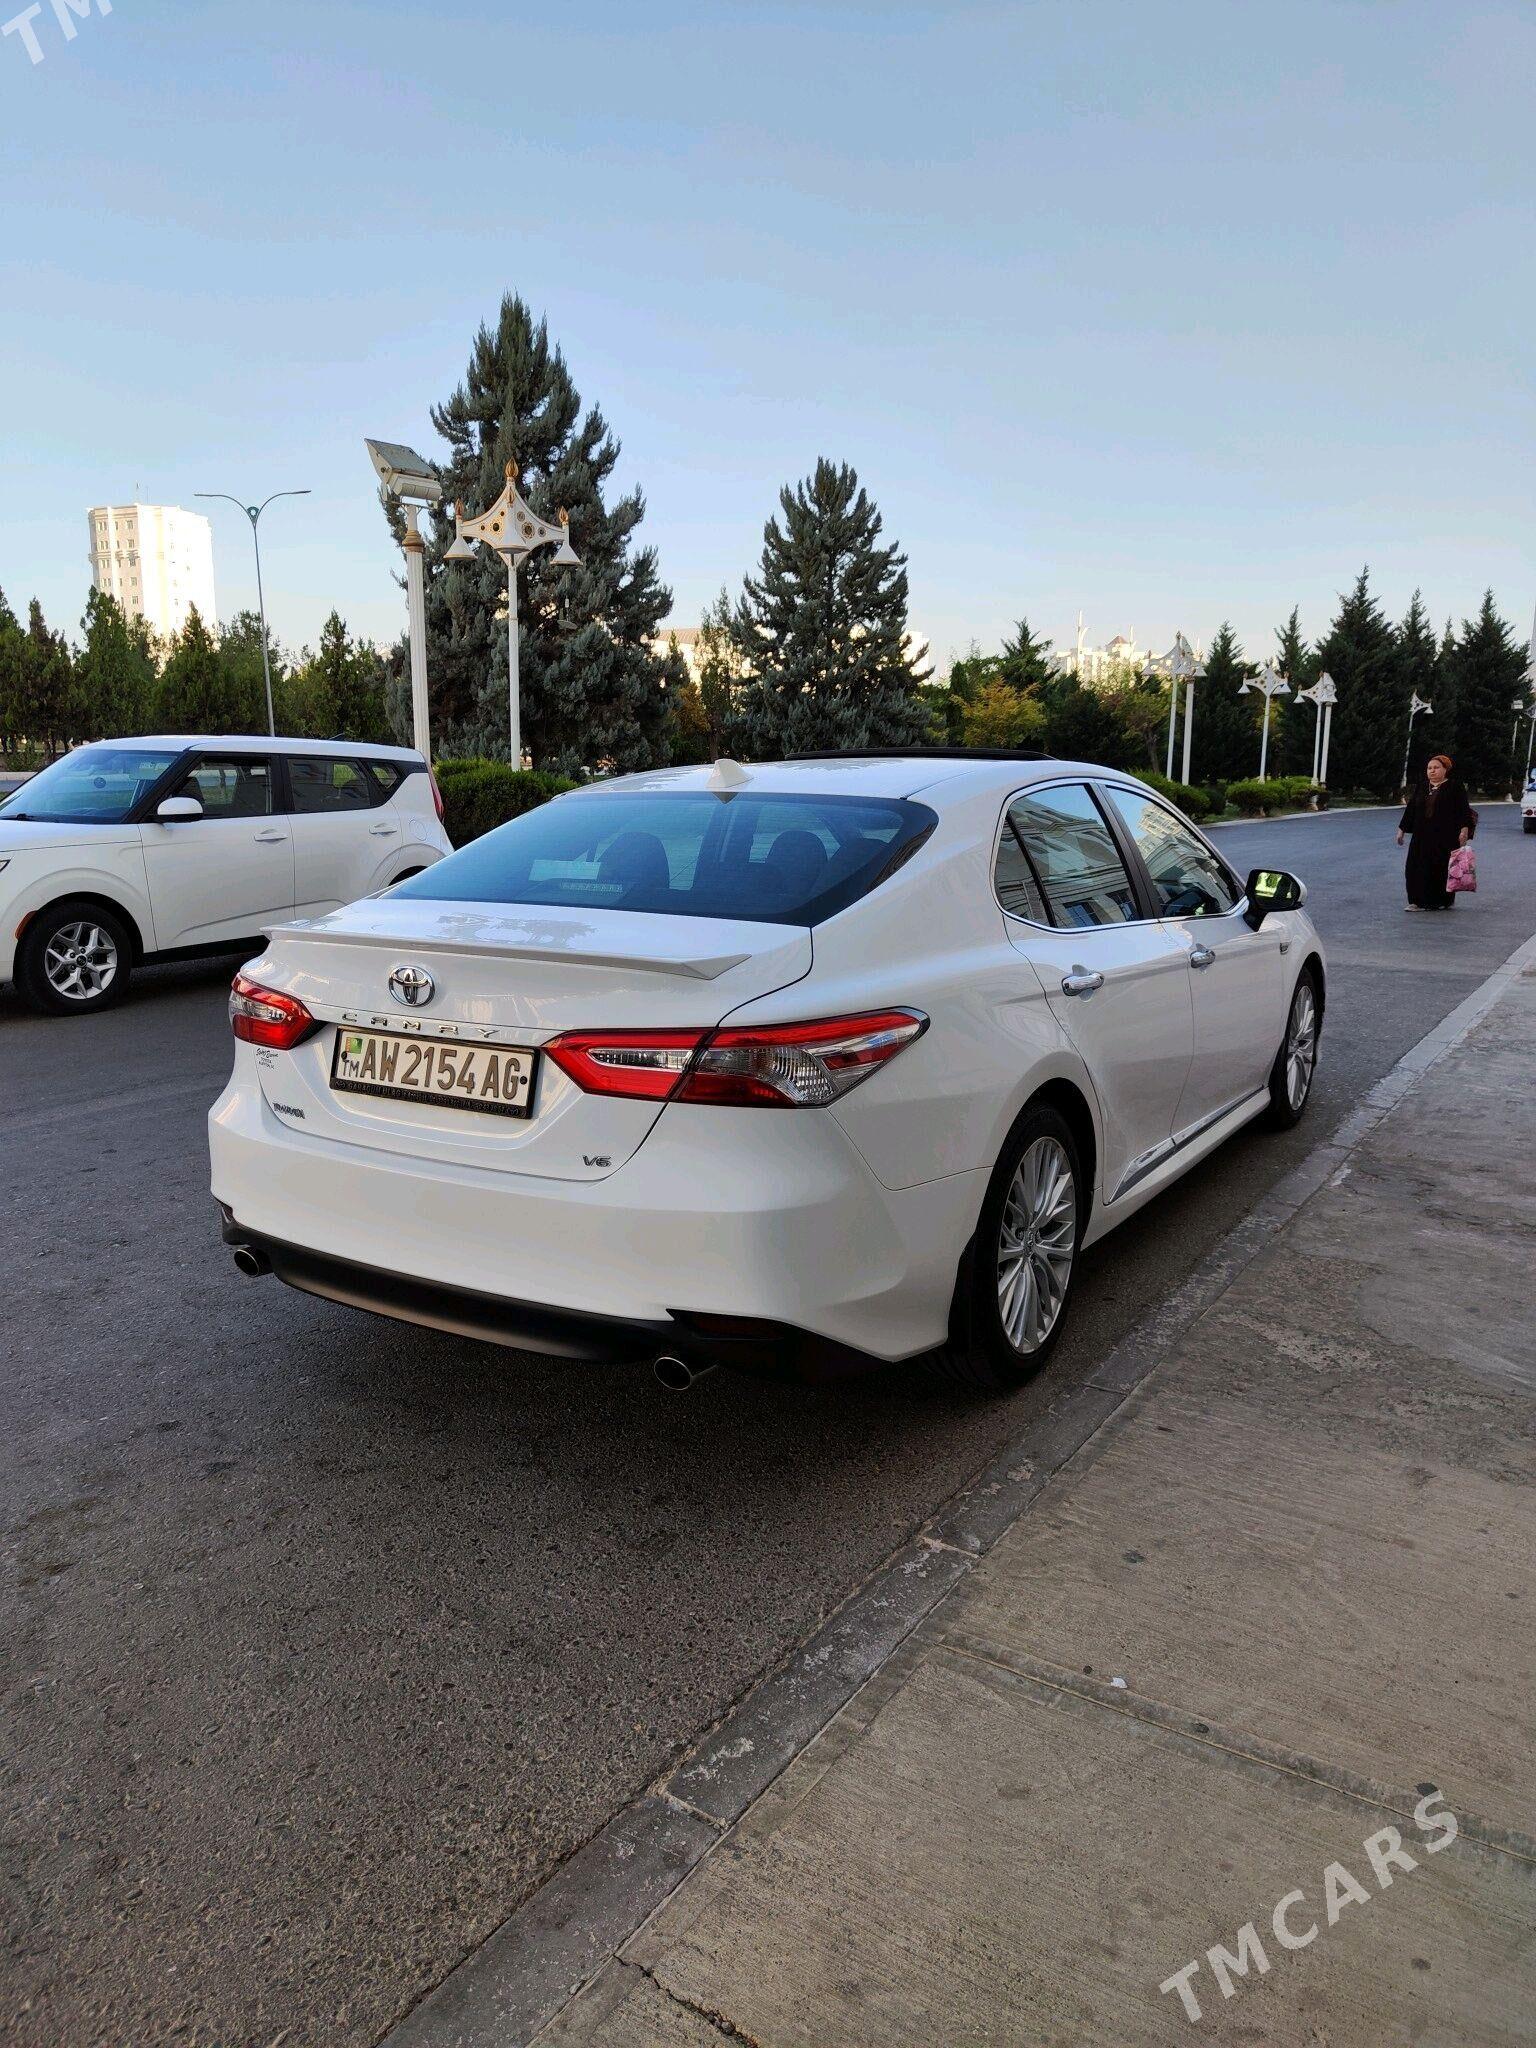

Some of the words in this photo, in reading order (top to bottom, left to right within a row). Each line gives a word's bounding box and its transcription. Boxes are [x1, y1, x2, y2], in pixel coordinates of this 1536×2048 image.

[342, 1012, 500, 1038] CAMRY
[343, 1059, 361, 1078] TM
[582, 1155, 611, 1167] V6
